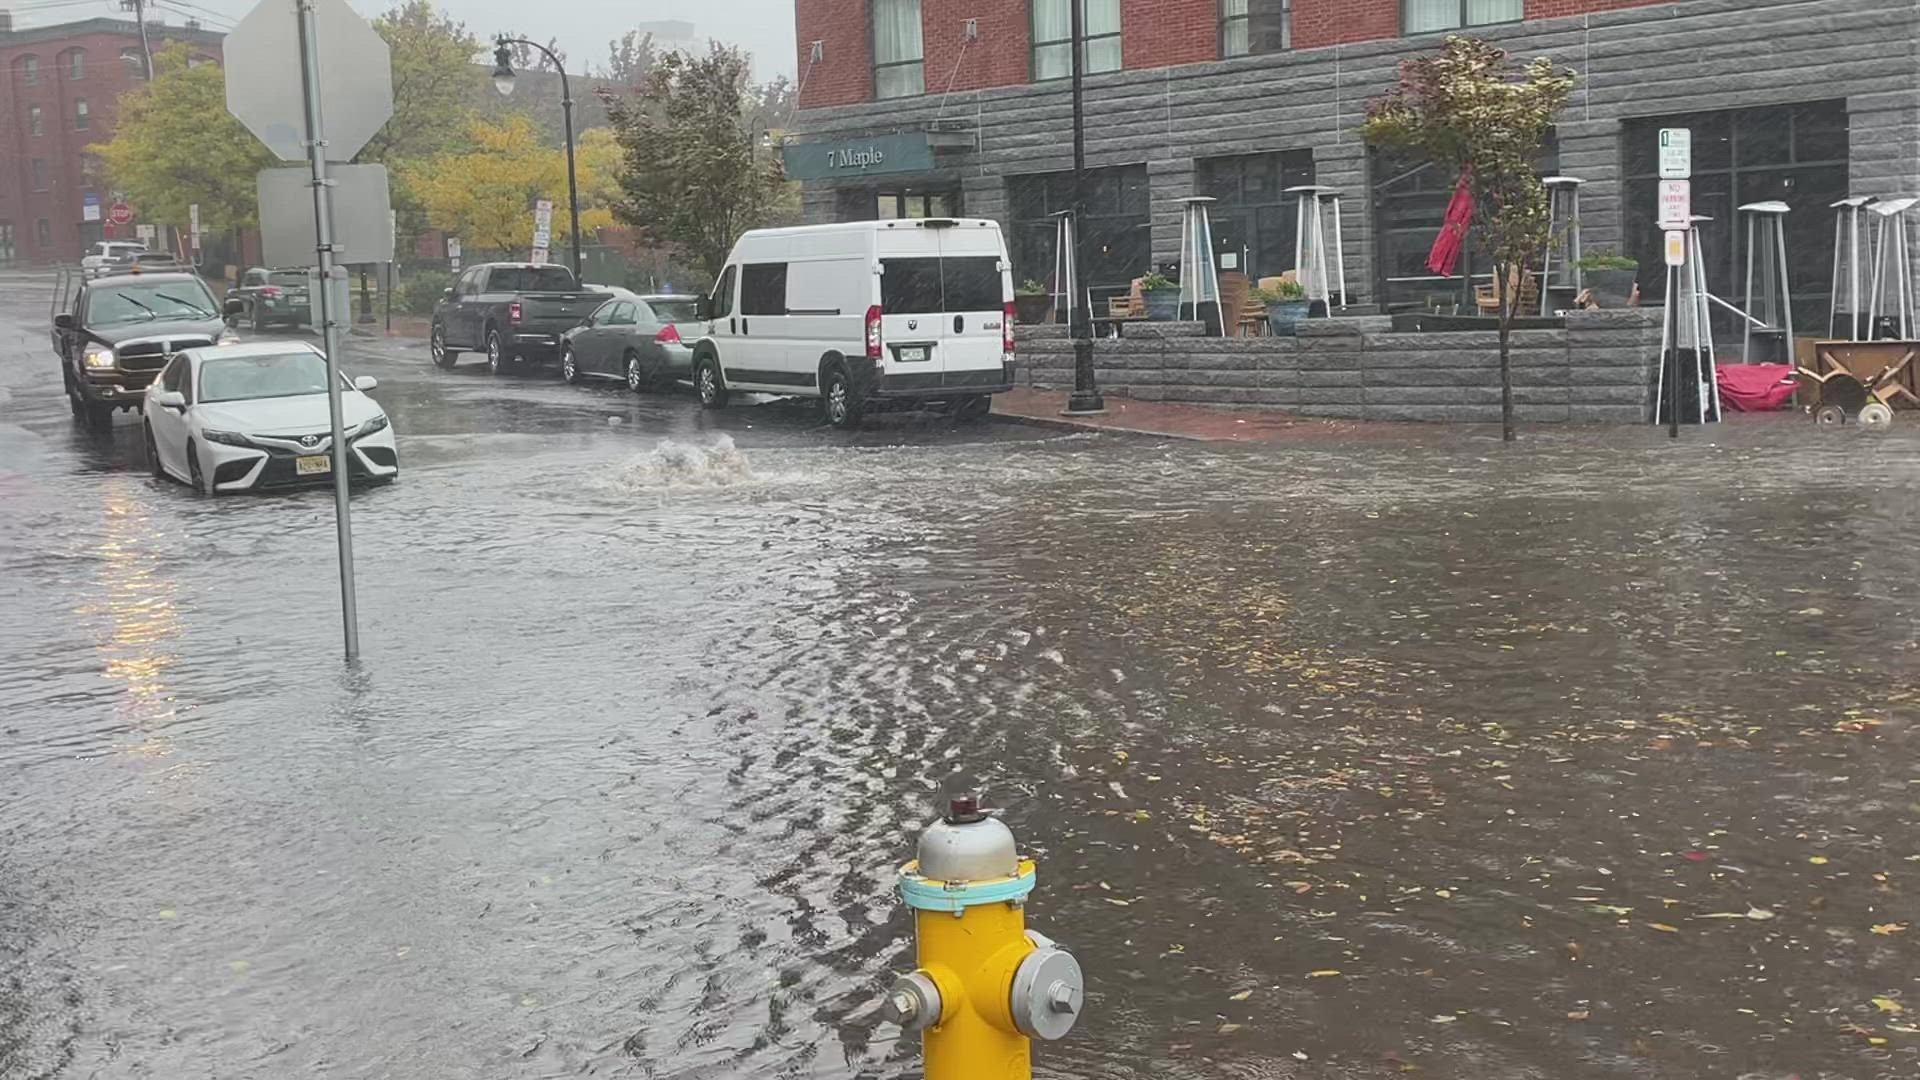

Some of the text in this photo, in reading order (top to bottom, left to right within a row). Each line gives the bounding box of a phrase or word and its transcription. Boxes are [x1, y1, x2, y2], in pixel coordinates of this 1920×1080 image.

[827, 146, 883, 169] 7 Maple
[1668, 184, 1681, 192] NO
[112, 209, 129, 217] STOP
